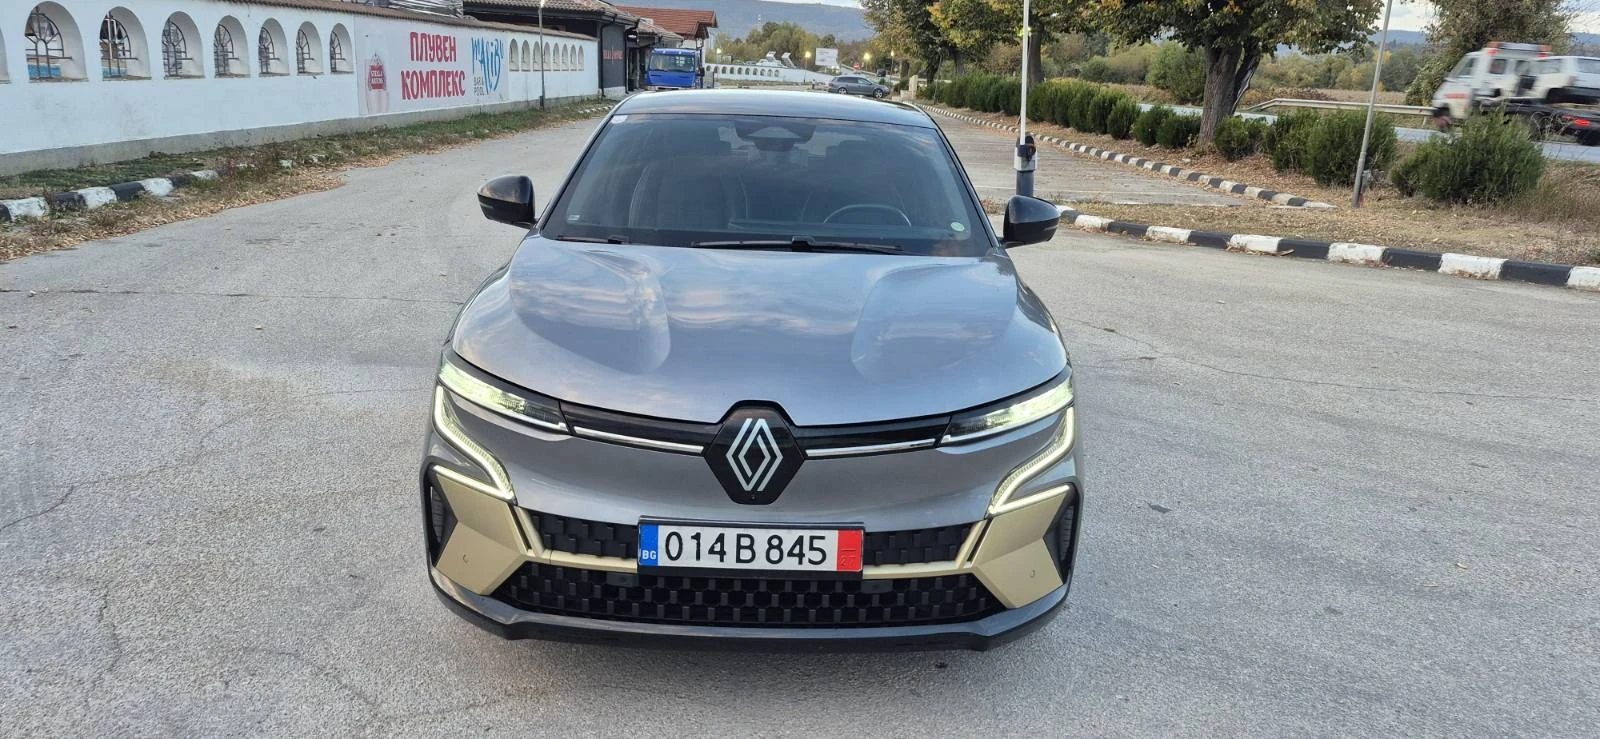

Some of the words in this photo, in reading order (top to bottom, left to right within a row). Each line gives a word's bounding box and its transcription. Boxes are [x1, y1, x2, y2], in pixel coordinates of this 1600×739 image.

[410, 32, 456, 62] ПЛУВЕН
[401, 70, 465, 100] КОМПЛЕКС
[642, 550, 657, 559] BG
